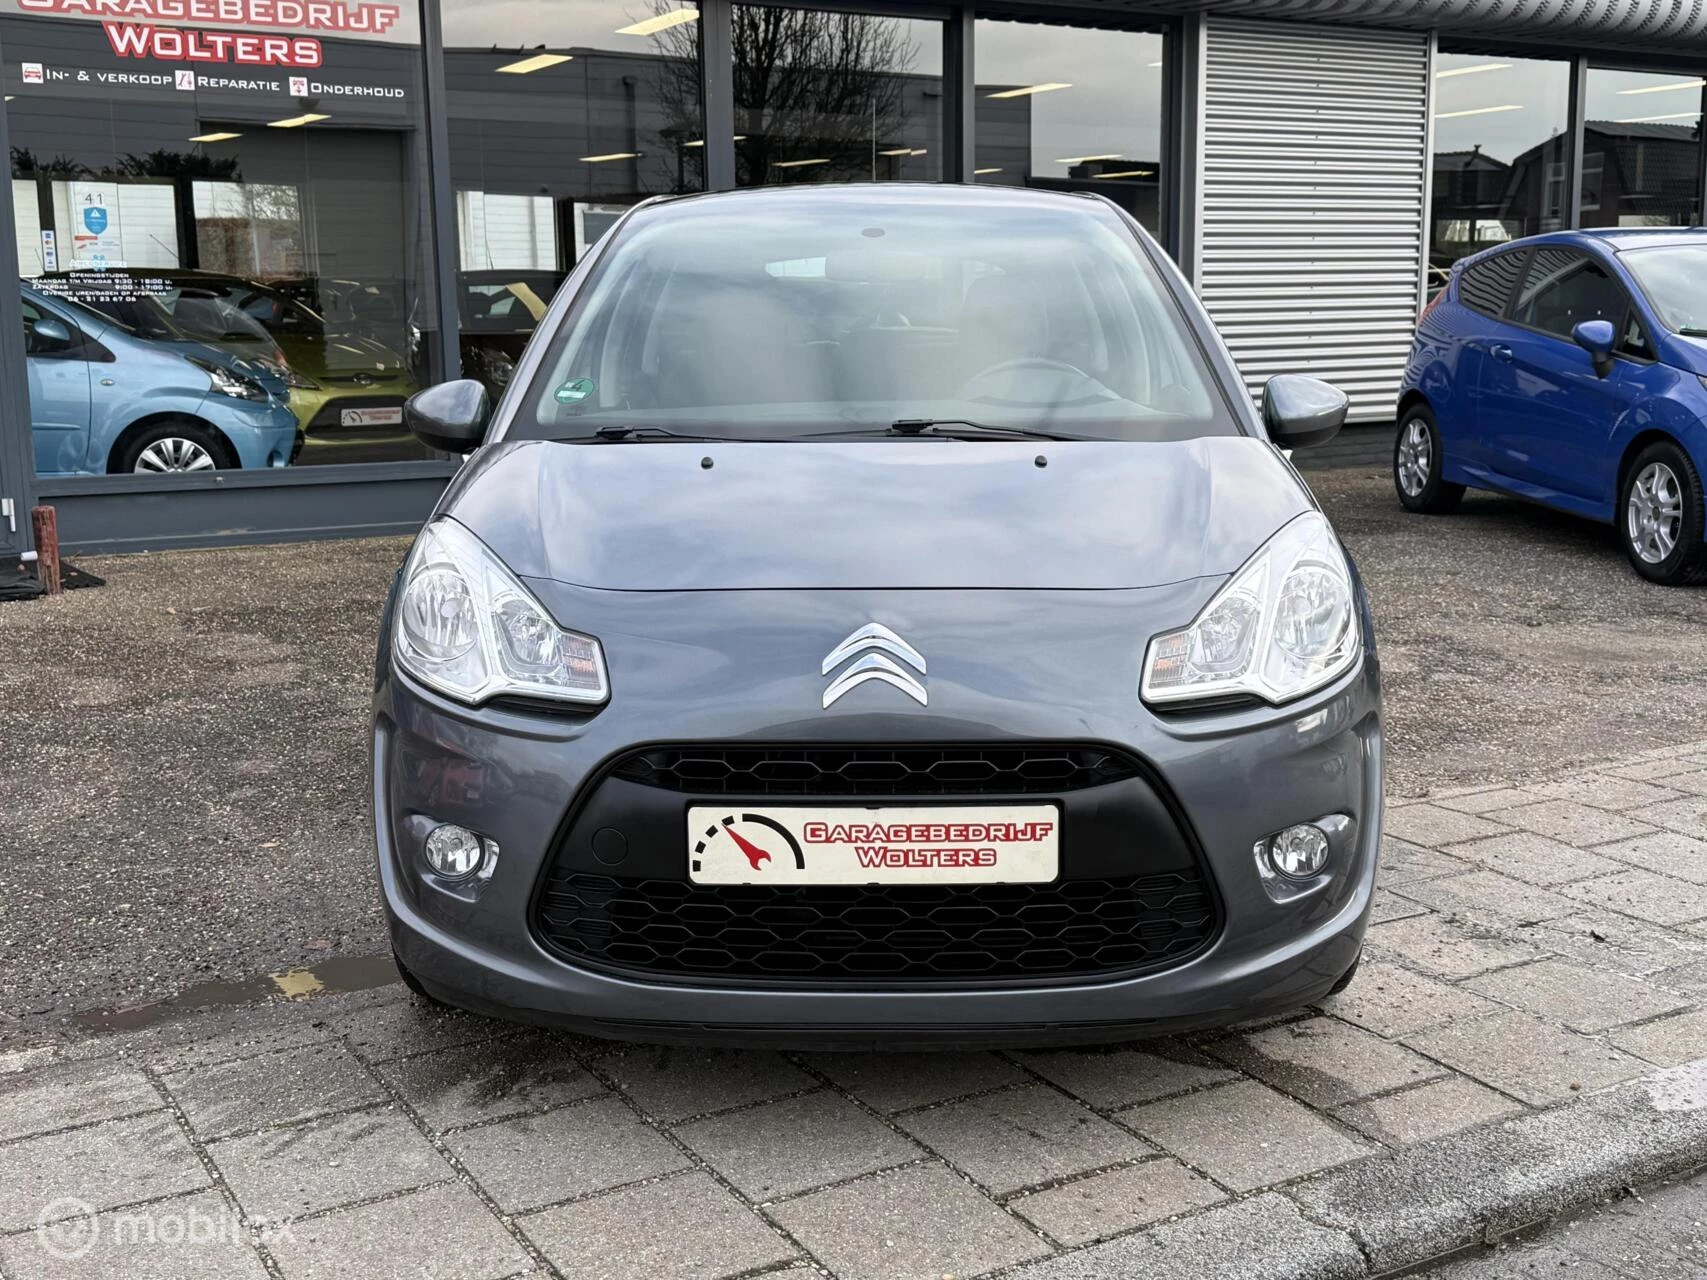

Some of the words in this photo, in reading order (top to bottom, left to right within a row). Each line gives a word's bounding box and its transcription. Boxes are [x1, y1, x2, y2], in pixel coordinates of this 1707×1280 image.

[102, 20, 322, 68] WOLTERS
[46, 69, 69, 80] IN-
[77, 71, 90, 81] &
[97, 73, 173, 85] VERKOOP
[198, 76, 280, 91] REPARATIE
[310, 82, 405, 98] ONDERHOUD
[804, 822, 1053, 843] GARAGEBEDRIJF
[855, 846, 997, 868] WOLTERS
